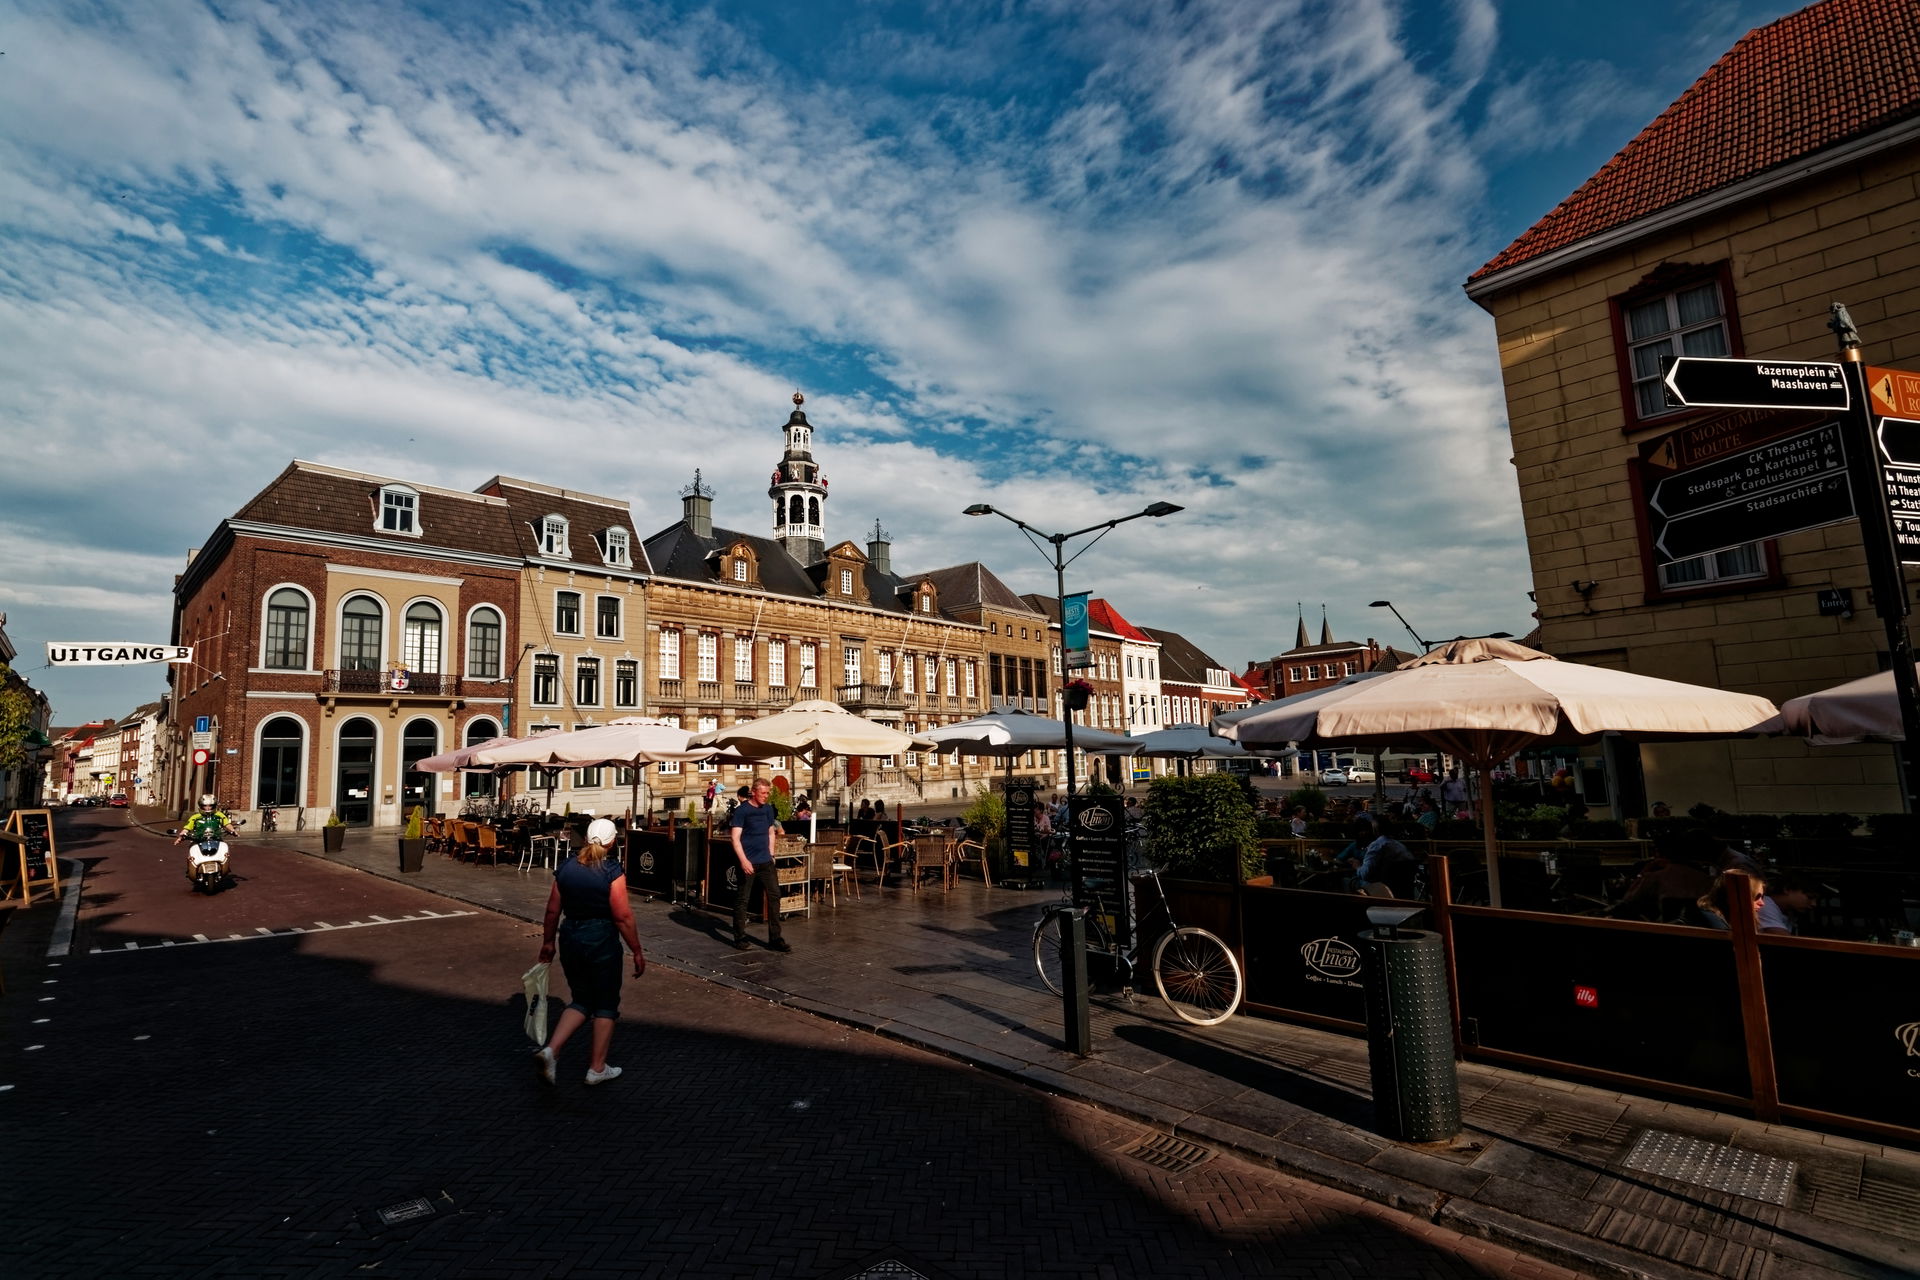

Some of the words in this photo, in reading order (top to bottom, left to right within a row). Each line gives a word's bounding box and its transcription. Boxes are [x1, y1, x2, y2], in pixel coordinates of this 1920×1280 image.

[1756, 365, 1826, 379] Kazerneplein
[1771, 378, 1828, 390] Maashaven
[1693, 433, 1742, 459] ROUTE
[1748, 452, 1764, 464] CK
[1767, 435, 1816, 459] Theater
[1687, 471, 1742, 496] Stadspark
[1745, 465, 1760, 478] De
[1764, 449, 1818, 472] Karthuis
[1740, 459, 1820, 491] Caroluskapel
[1746, 481, 1825, 512] Stadsarchief
[51, 647, 164, 662] UITGANG
[176, 647, 189, 659] B
[1301, 936, 1357, 970] Union
[1305, 973, 1323, 983] Coffee
[1576, 988, 1595, 1005] illy
